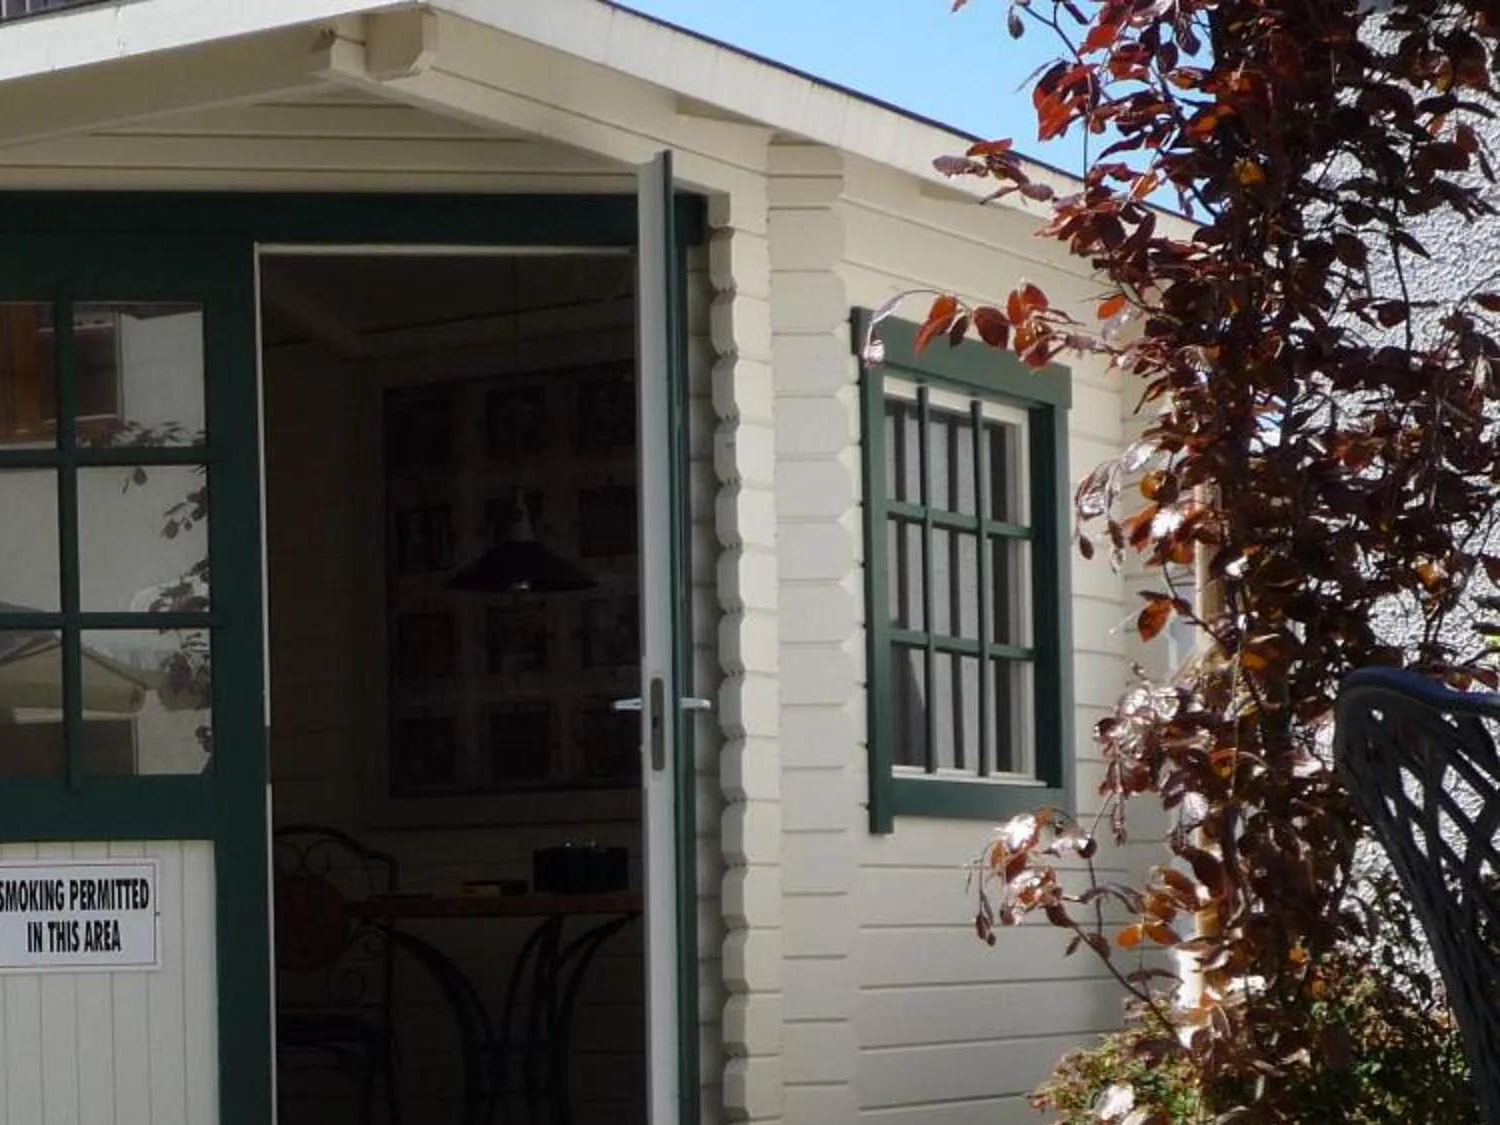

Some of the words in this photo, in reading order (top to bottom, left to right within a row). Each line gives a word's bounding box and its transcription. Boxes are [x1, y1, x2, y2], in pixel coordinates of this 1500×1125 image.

[69, 878, 149, 911] PERMITTED
[27, 921, 43, 952] IN
[47, 920, 80, 952] THIS
[84, 920, 121, 952] AREA
